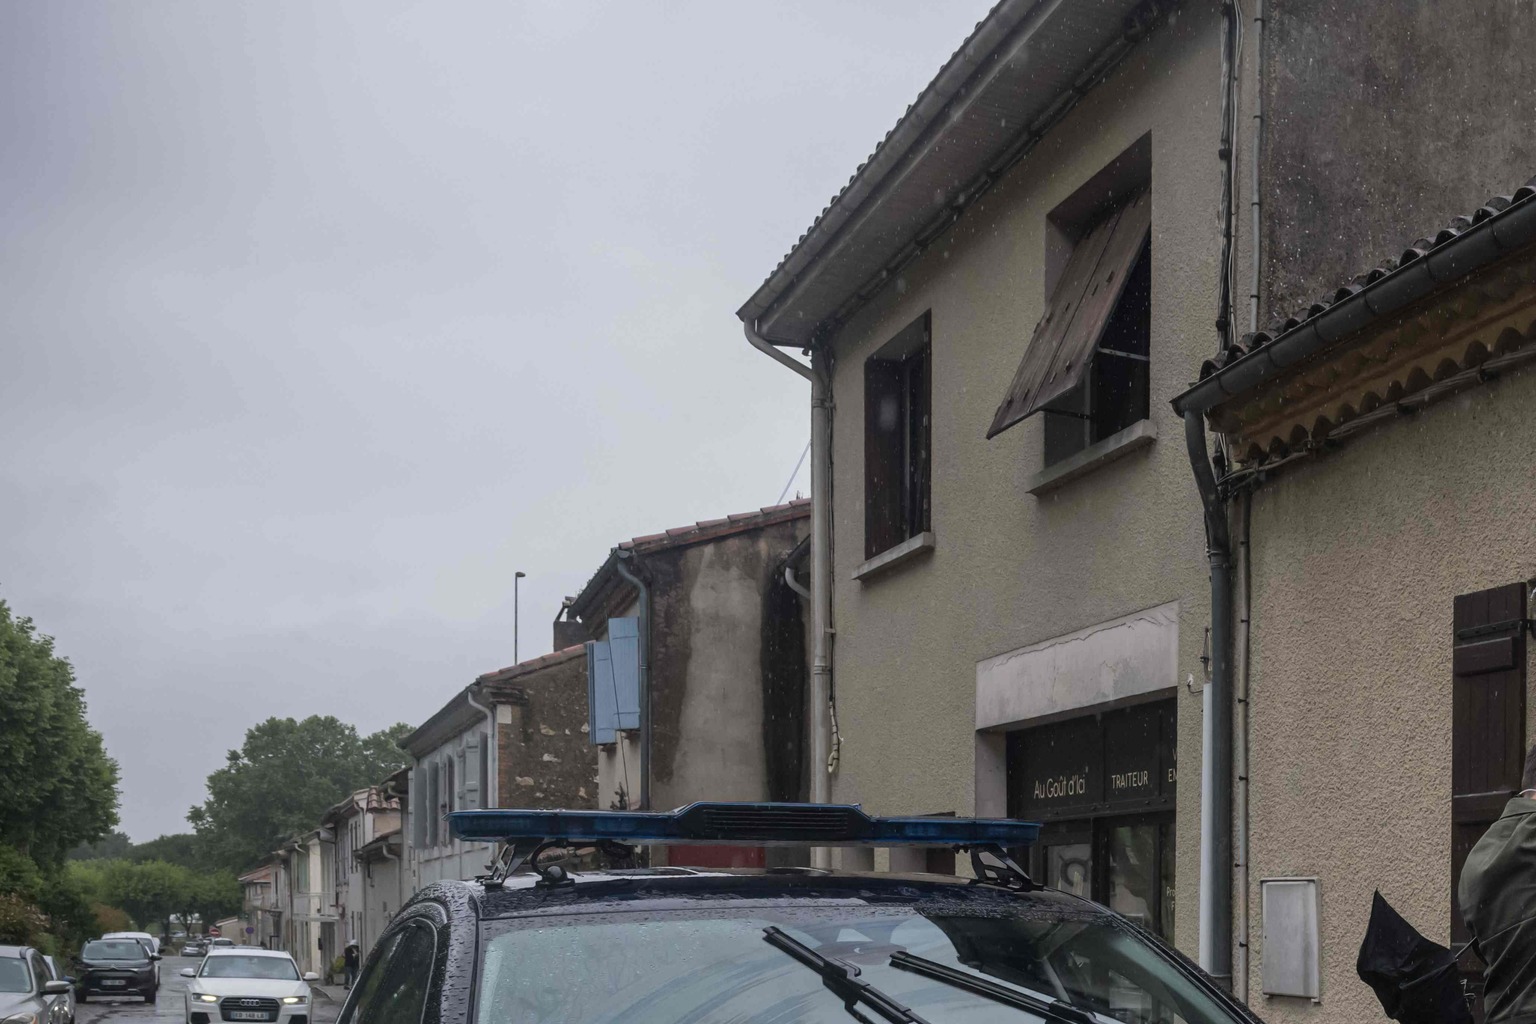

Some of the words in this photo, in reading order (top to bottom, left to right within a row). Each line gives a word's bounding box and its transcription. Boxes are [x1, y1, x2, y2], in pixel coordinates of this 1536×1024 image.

[1033, 780, 1045, 799] Au
[1046, 775, 1067, 798] Goût
[1111, 770, 1149, 789] TRAITEUR
